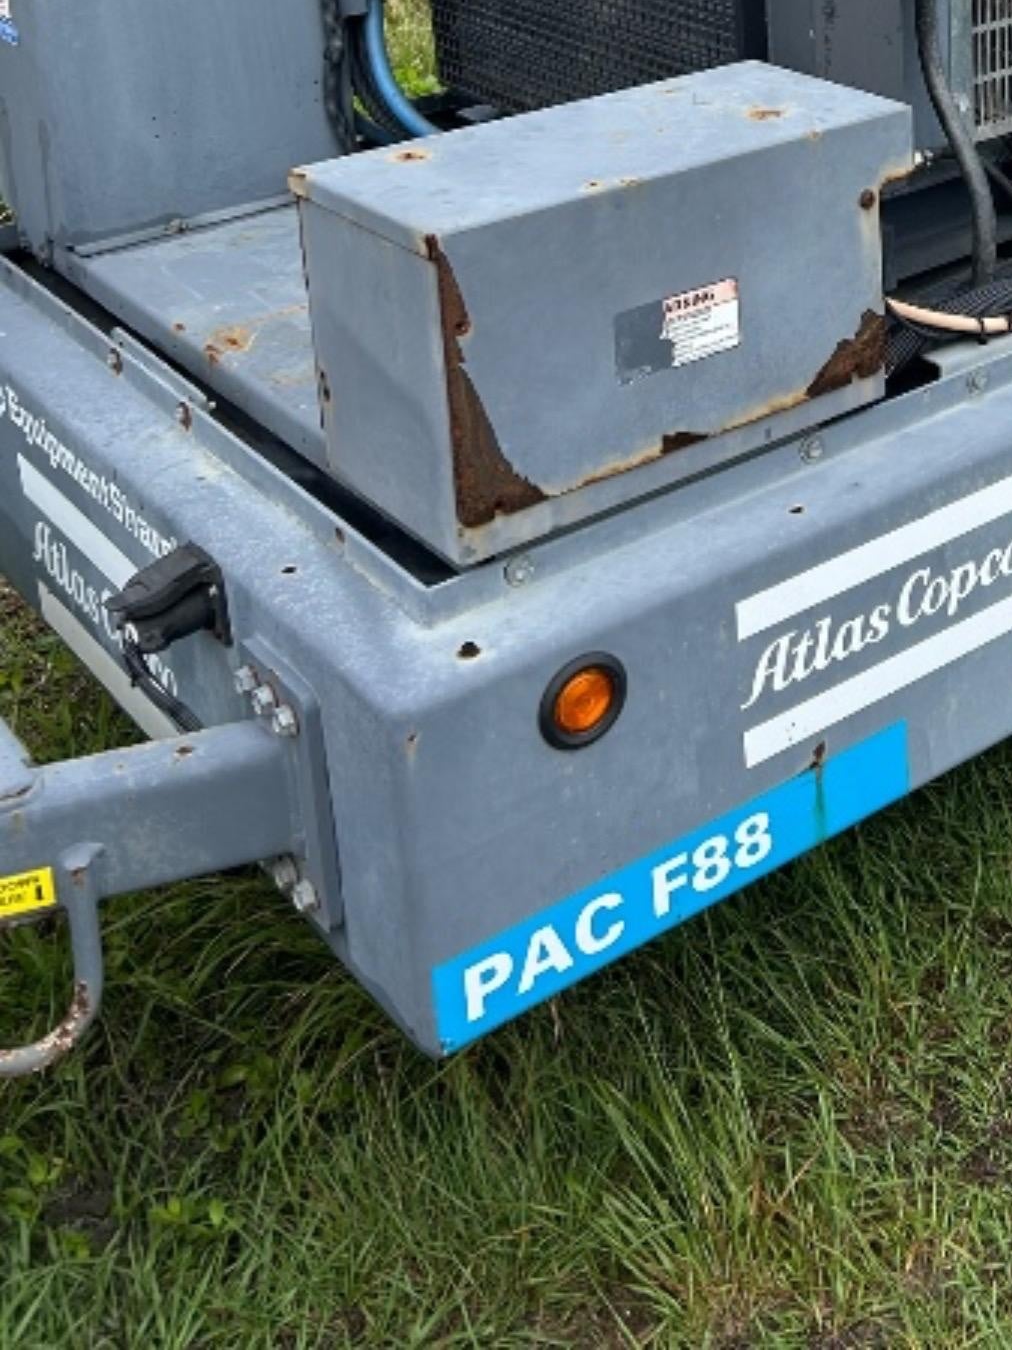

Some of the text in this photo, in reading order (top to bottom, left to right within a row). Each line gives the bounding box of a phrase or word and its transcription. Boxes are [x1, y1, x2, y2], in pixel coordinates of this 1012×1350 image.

[740, 603, 891, 711] Atlas
[464, 812, 773, 1023] PAC F88
